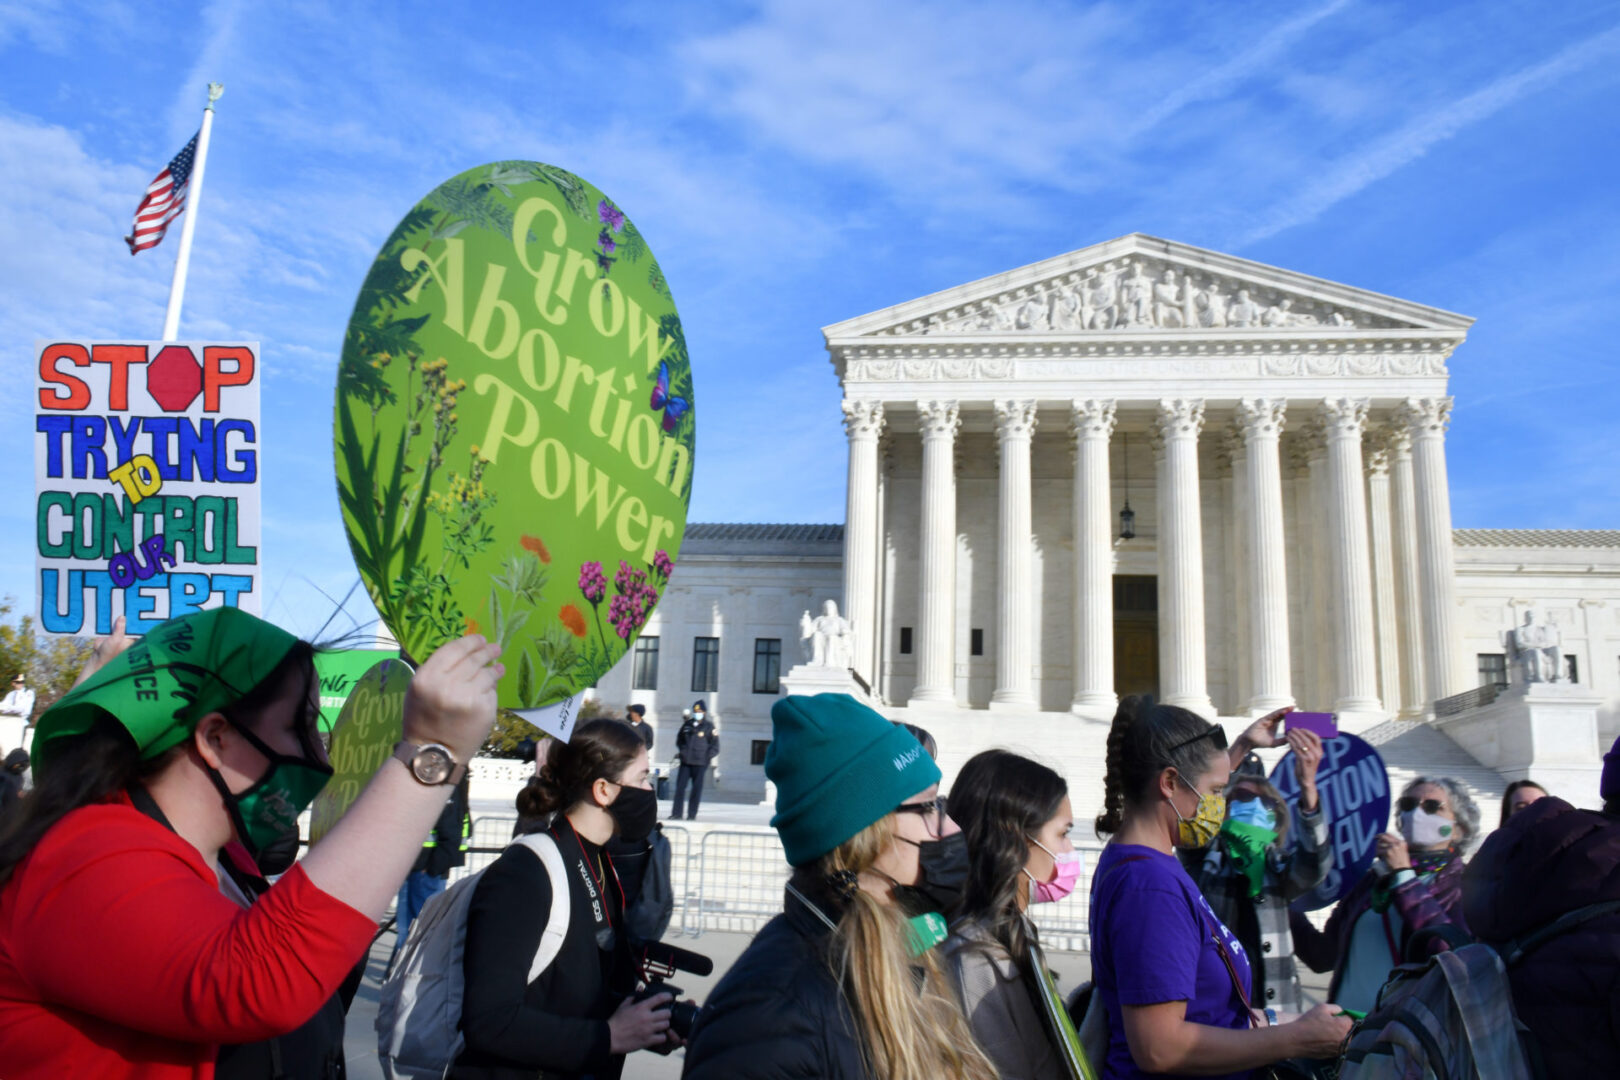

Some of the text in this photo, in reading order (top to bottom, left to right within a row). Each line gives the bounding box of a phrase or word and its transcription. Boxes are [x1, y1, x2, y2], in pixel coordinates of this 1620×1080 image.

[512, 197, 675, 375] Grow
[401, 238, 689, 498] Abortion
[36, 415, 257, 484] TRYING
[108, 454, 163, 505] TO
[473, 373, 675, 567] Power
[37, 491, 257, 565] CONTROL
[109, 534, 177, 588] OUR
[578, 859, 603, 922] EOS DIGITAL
